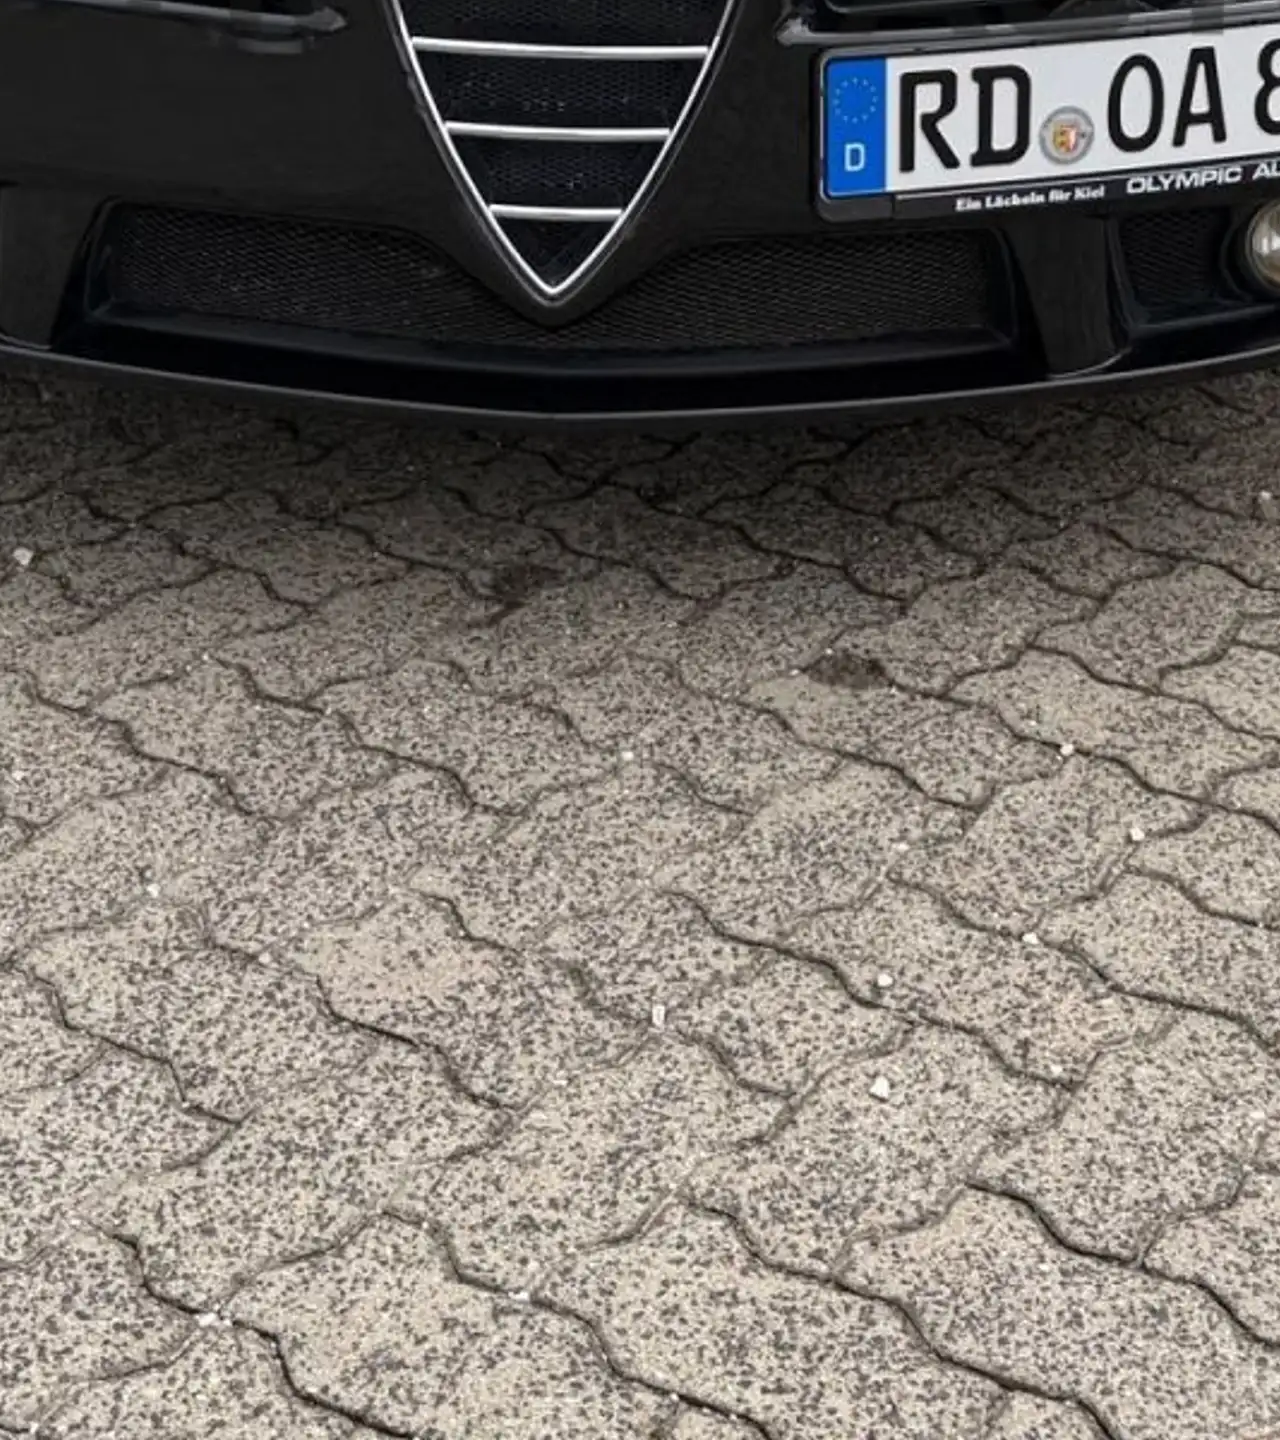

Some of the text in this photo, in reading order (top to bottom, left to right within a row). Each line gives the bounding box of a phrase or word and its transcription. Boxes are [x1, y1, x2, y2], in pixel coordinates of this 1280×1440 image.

[899, 64, 1032, 173] RD
[1107, 46, 1228, 153] OA
[844, 143, 865, 172] D
[1074, 185, 1106, 200] Kiel
[1126, 166, 1244, 195] OLYMPIC
